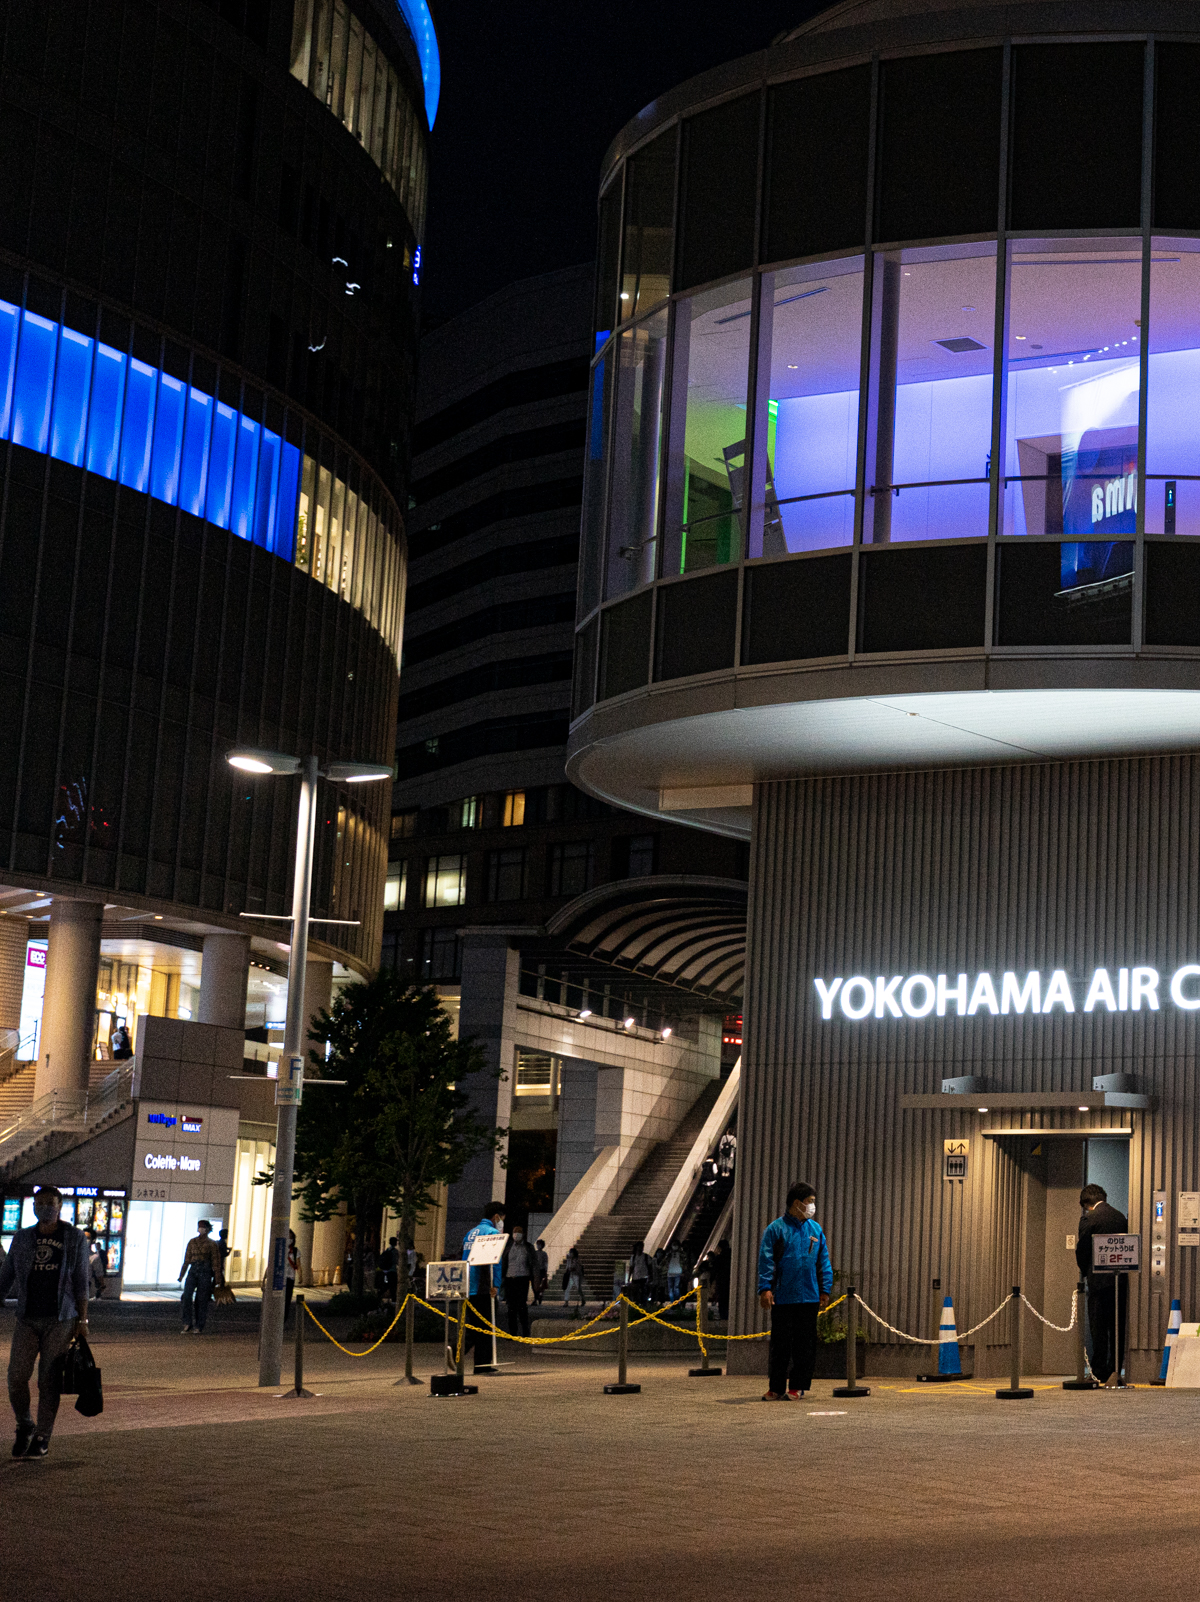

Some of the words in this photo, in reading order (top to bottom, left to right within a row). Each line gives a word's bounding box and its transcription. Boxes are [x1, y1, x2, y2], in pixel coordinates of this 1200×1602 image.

[814, 970, 1074, 1020] YOKOHAMA
[1084, 967, 1159, 1013] AIR
[183, 1124, 201, 1132] IMAX
[76, 1187, 98, 1196] IMAX
[137, 1189, 165, 1198] シネマ入口
[34, 1263, 59, 1271] ITCH
[436, 1266, 463, 1283] 入口
